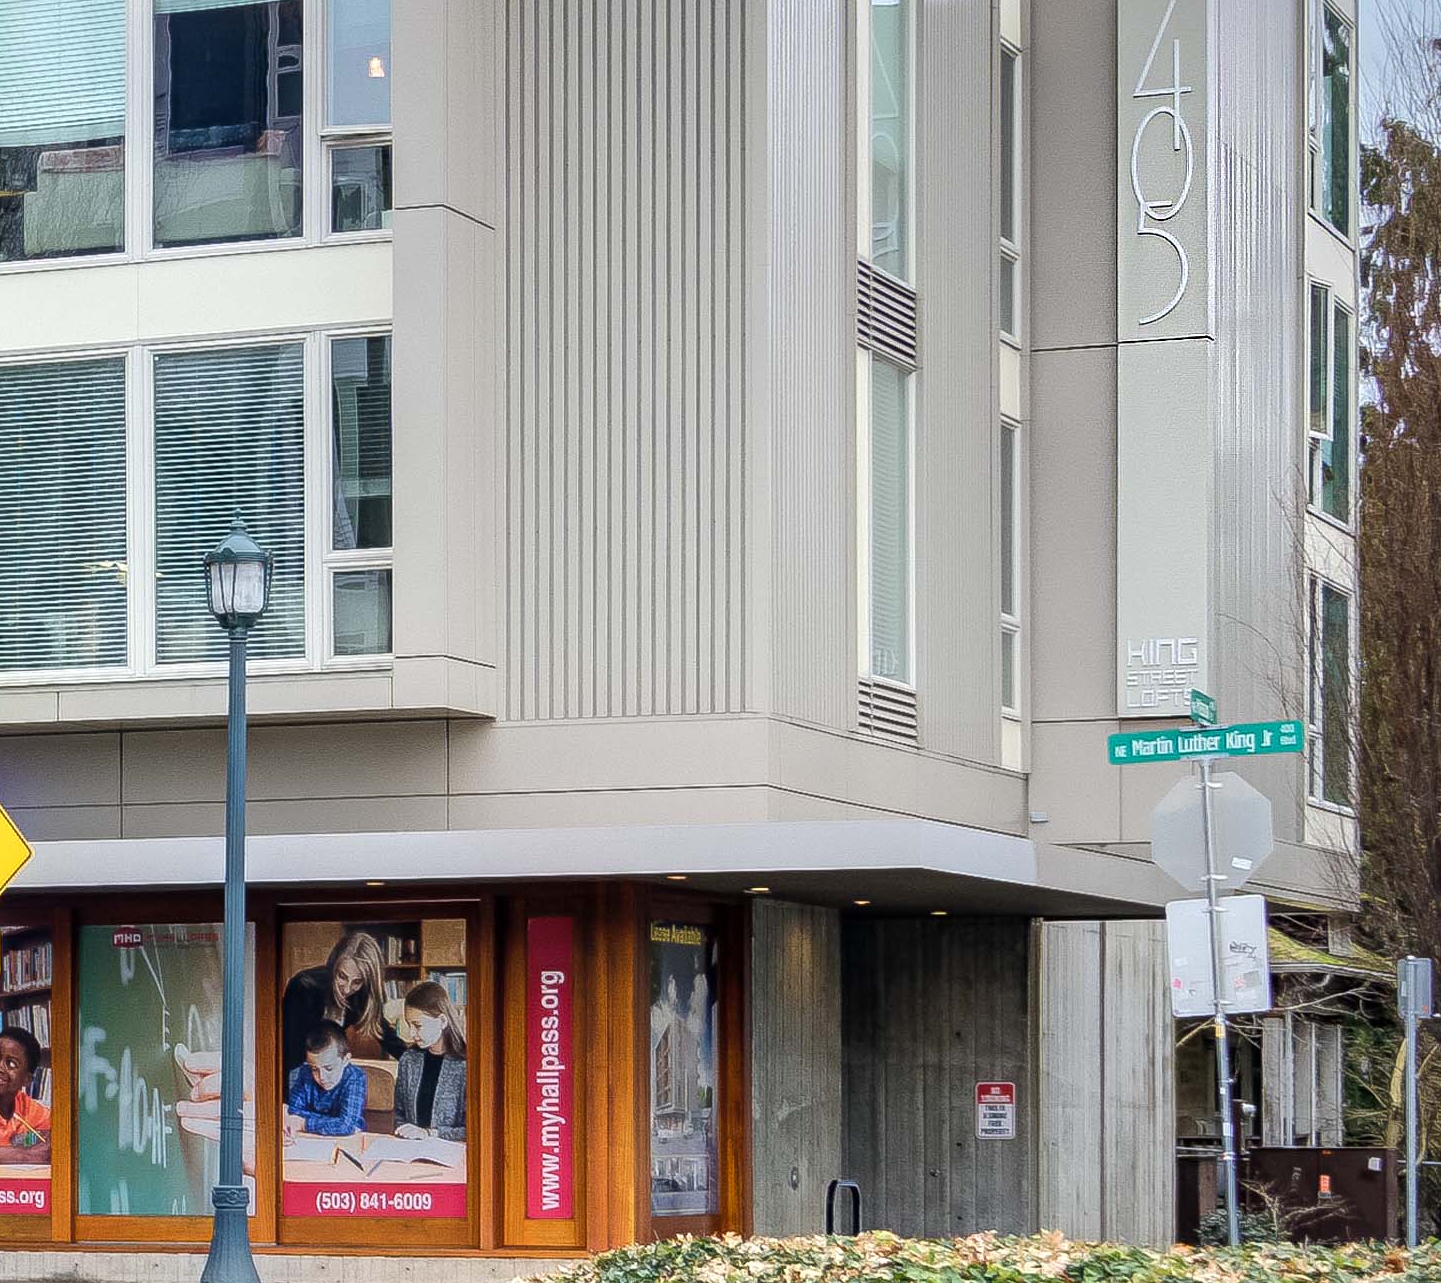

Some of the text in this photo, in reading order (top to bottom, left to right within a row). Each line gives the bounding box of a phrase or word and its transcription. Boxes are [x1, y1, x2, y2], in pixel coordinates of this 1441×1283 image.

[1126, 637, 1198, 667] KING
[1126, 669, 1198, 686] STREET
[1114, 729, 1273, 757] NE Martin Luther King Jr
[1280, 735, 1296, 745] Blvd
[536, 970, 566, 1211] www.myhallpass.org
[315, 1191, 432, 1213] (503) 841-6009
